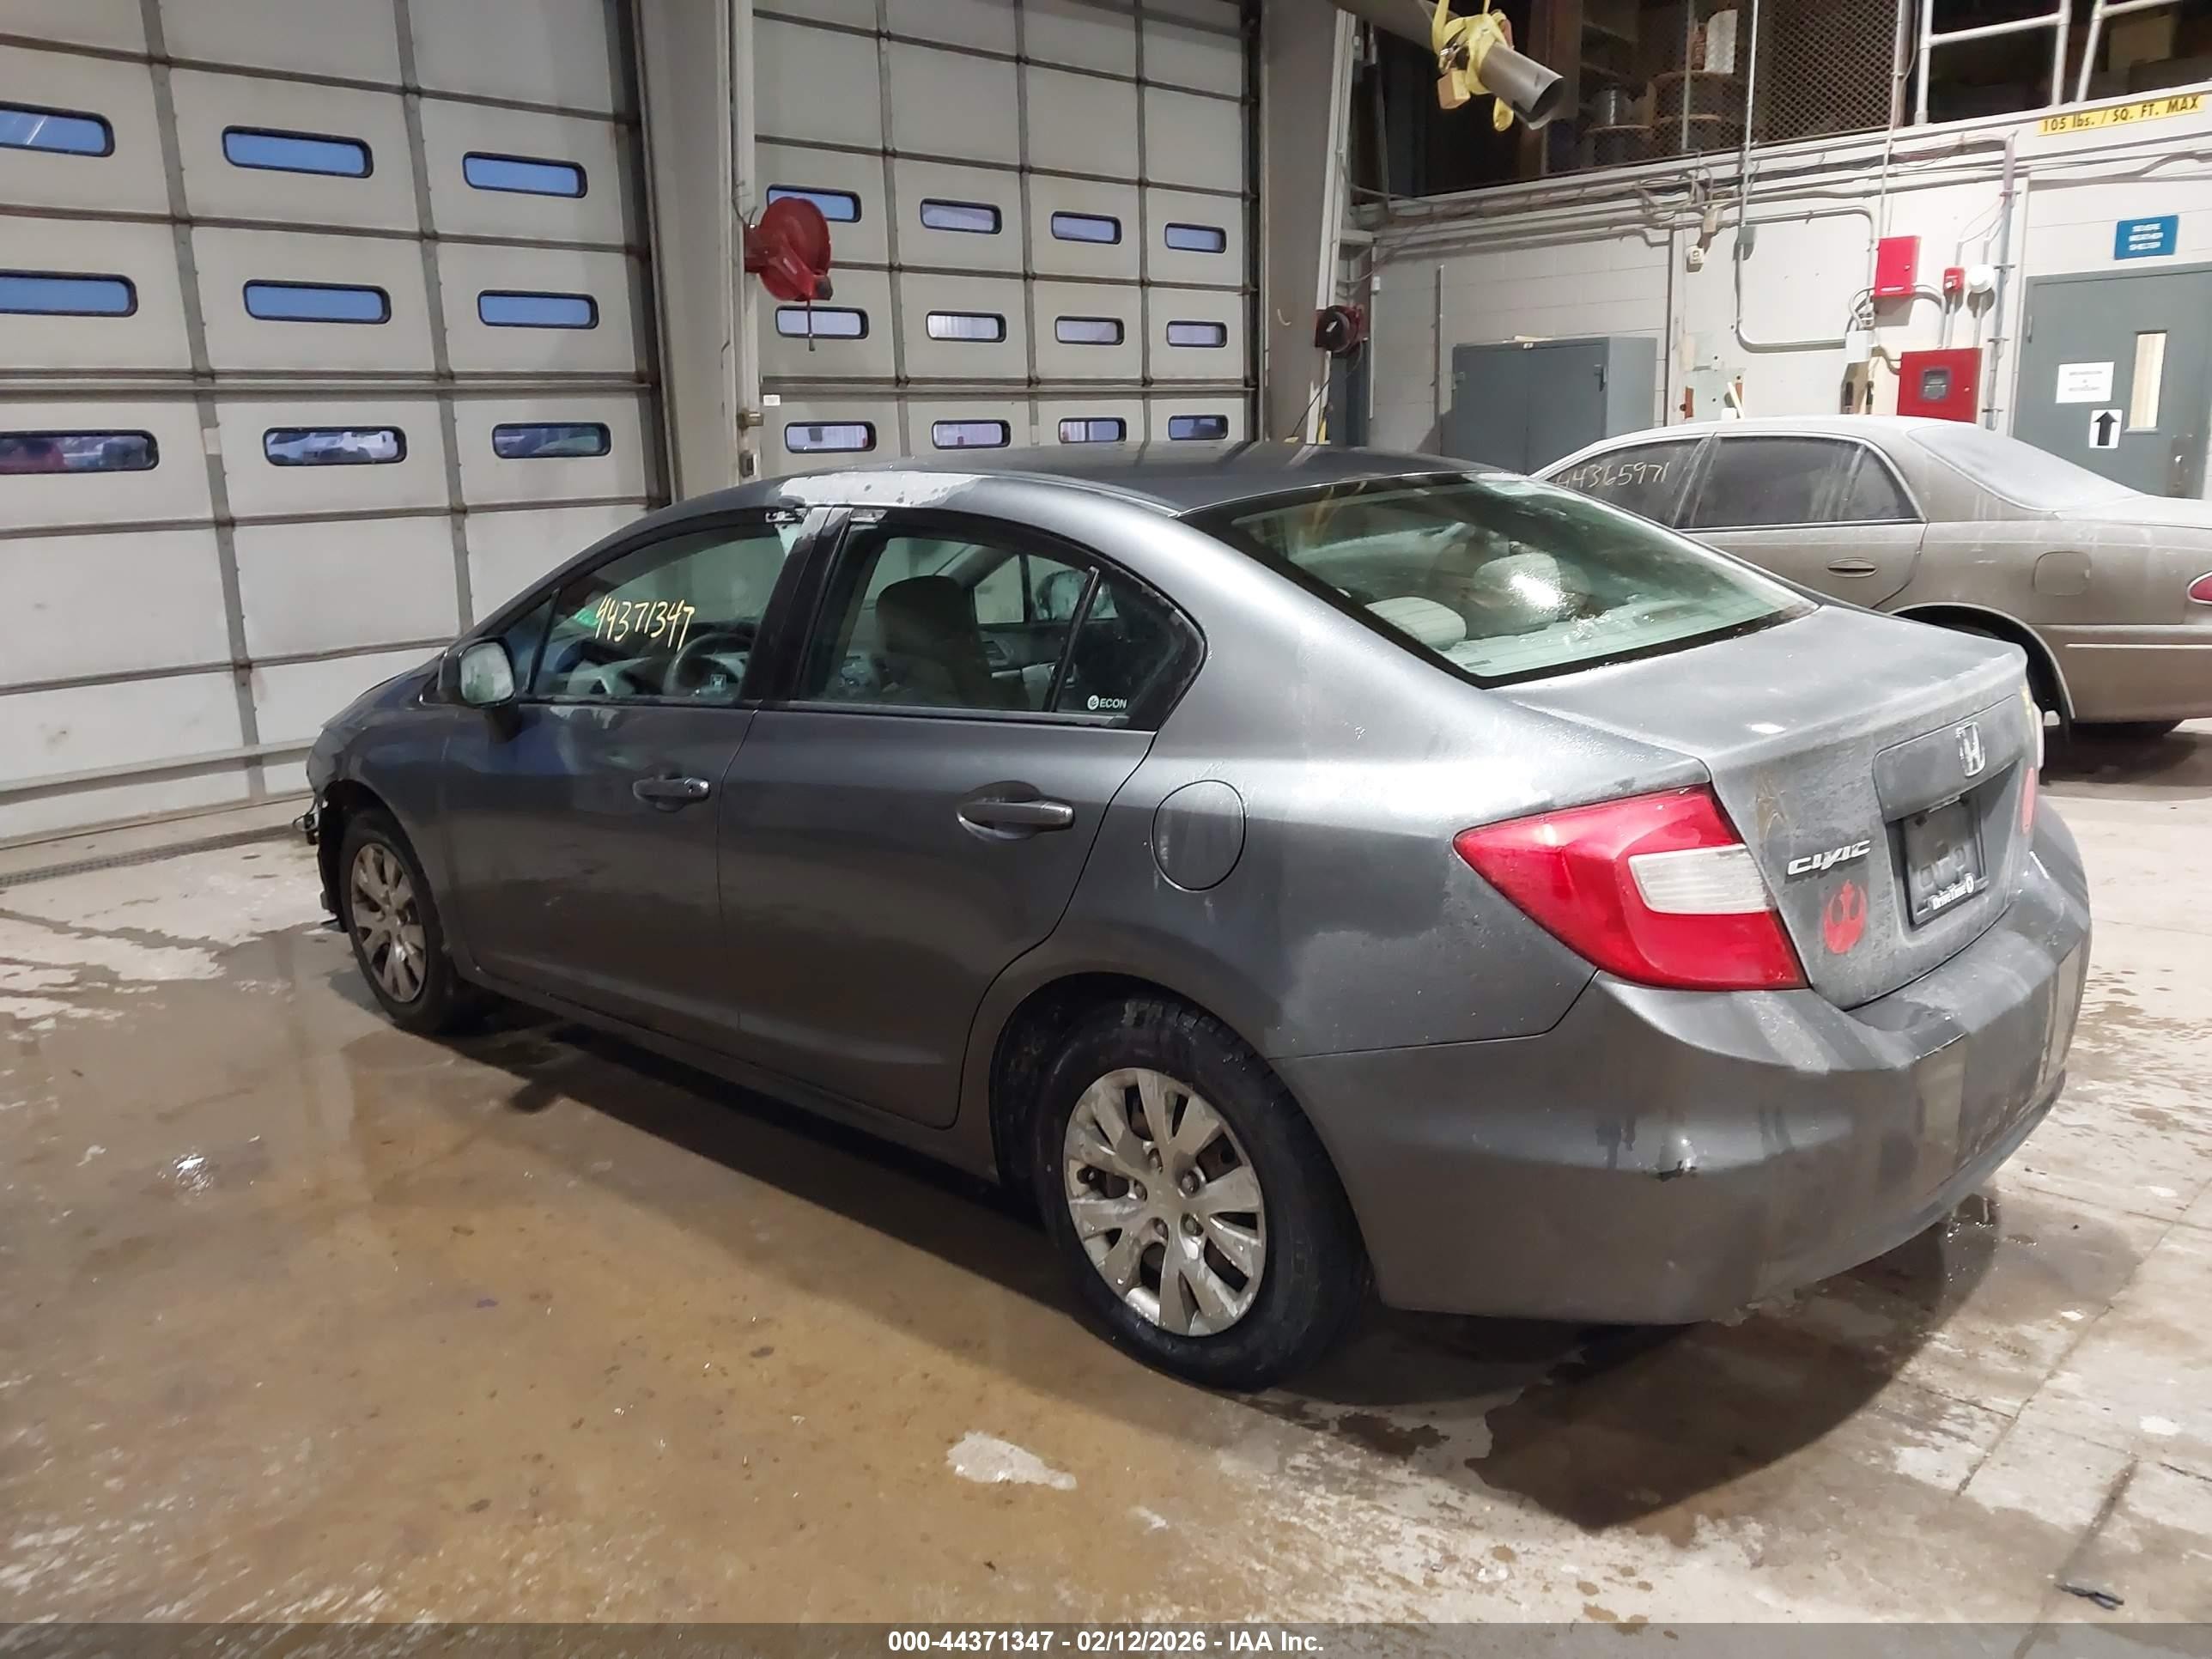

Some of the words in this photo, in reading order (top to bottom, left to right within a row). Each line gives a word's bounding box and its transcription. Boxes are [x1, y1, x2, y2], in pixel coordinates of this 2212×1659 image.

[2043, 117, 2066, 131] 105
[2072, 116, 2095, 128] lbs.
[2112, 108, 2133, 122] SQ.
[2140, 104, 2159, 118] FT.
[2166, 94, 2200, 113] MAX
[1555, 462, 1669, 489] 44365971
[595, 594, 696, 653] 44371347
[1099, 698, 1127, 708] ECON
[1788, 840, 1870, 875] CIVIC
